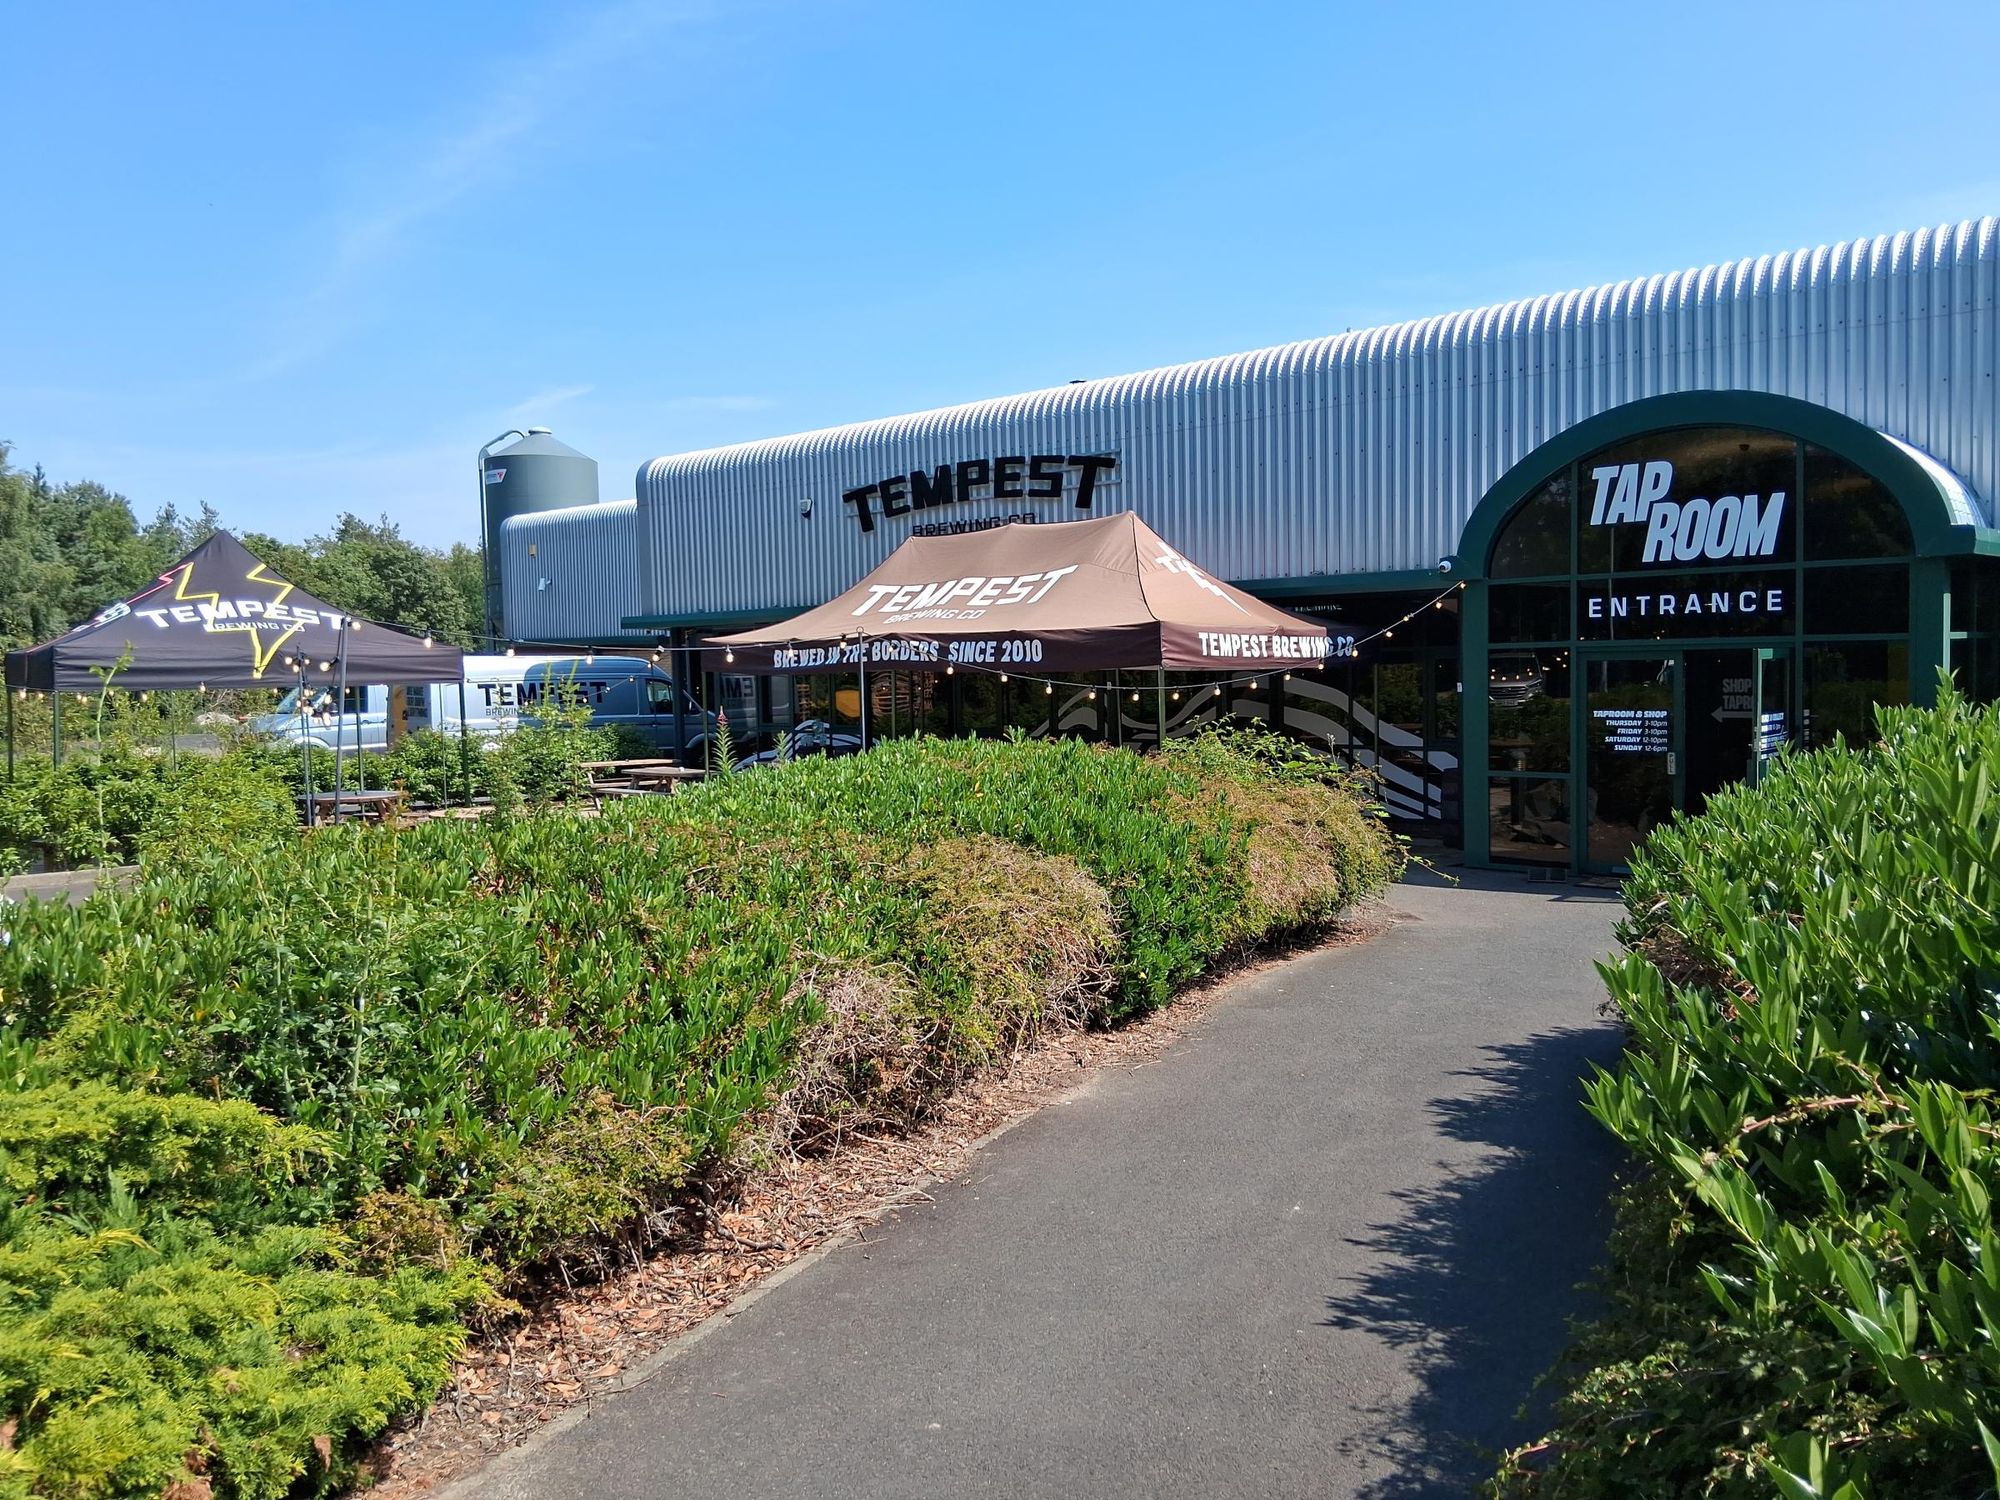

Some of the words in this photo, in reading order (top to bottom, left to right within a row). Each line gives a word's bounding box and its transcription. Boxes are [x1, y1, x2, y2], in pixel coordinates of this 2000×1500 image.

[842, 455, 1117, 532] TEMPEST
[1590, 461, 1673, 526] TAP
[912, 516, 1001, 537] BREWING
[1642, 492, 1786, 563] ROOM
[851, 564, 1080, 617] TEMPEST
[1588, 589, 1783, 618] ENTRANCE
[135, 600, 346, 631] TEMPEST
[883, 608, 958, 625] BREWING
[956, 609, 987, 621] CO
[773, 647, 826, 669] BREWED
[825, 646, 841, 665] IN
[842, 642, 870, 664] THE
[871, 639, 938, 663] BORDERS
[948, 640, 998, 663] SINCE
[1000, 639, 1043, 663] 2010
[1198, 631, 1269, 658] TEMPEST
[1272, 635, 1335, 659] BREWING
[1336, 635, 1355, 658] CO
[1722, 678, 1752, 693] SHOP
[1722, 695, 1753, 710] TAPR
[1643, 710, 1667, 718] SHOP
[1644, 720, 1668, 728] 3-10pm
[1642, 736, 1668, 744] 12-10pm
[1644, 728, 1668, 736] 3-10pm
[1644, 745, 1668, 753] 12-6pm
